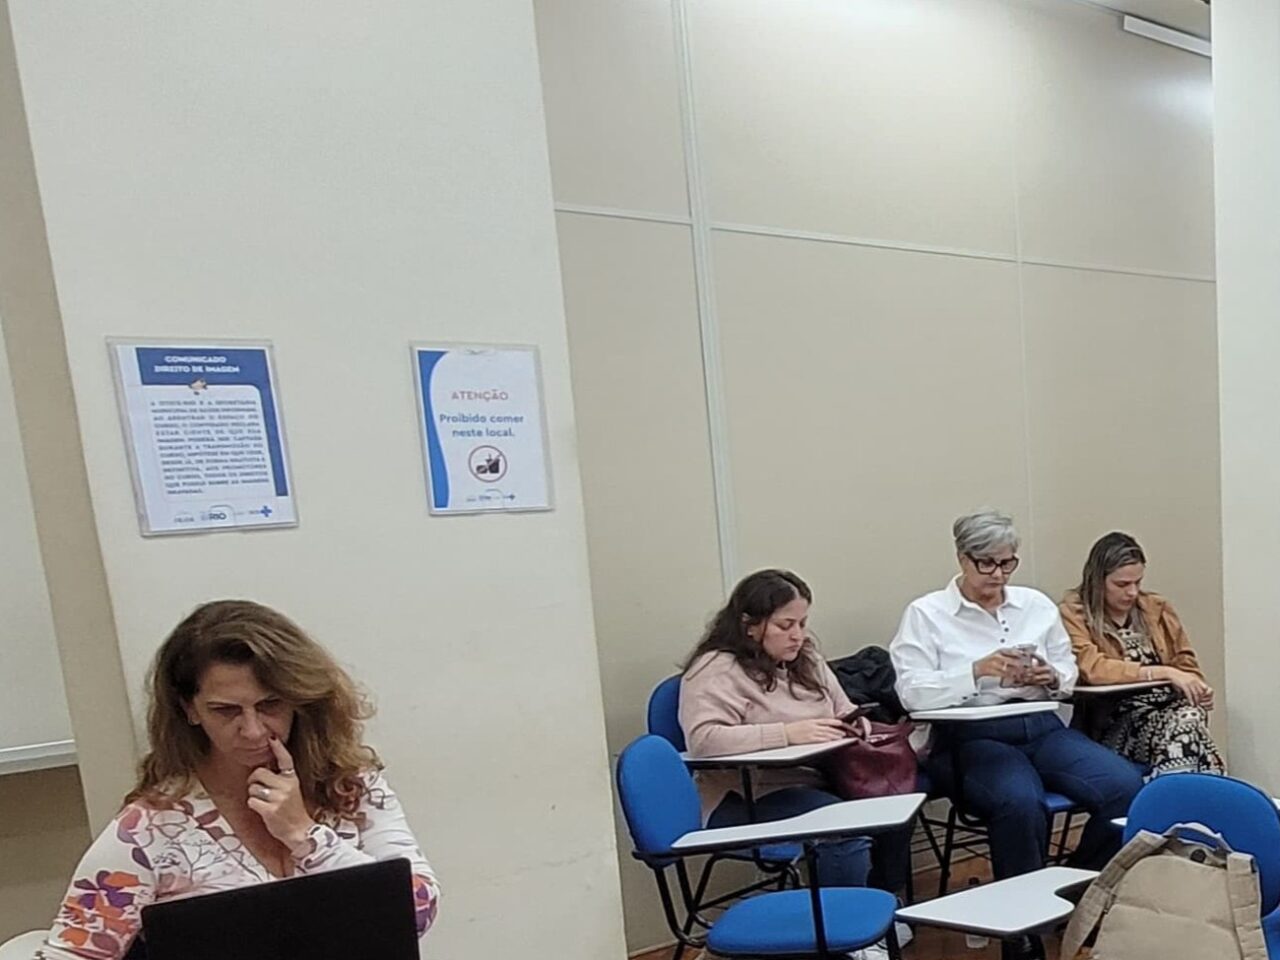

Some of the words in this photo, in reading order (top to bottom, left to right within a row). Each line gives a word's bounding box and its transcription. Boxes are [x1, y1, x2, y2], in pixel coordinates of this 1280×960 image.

[164, 355, 227, 363] COMUNICADO
[154, 365, 190, 373] DIREITO
[192, 365, 204, 373] DE
[205, 365, 240, 373] IMAGEM
[451, 388, 509, 402] ATENÇÃO
[440, 412, 487, 423] Proibido
[489, 415, 524, 423] comer
[452, 429, 483, 437] neste
[486, 427, 515, 437] local.
